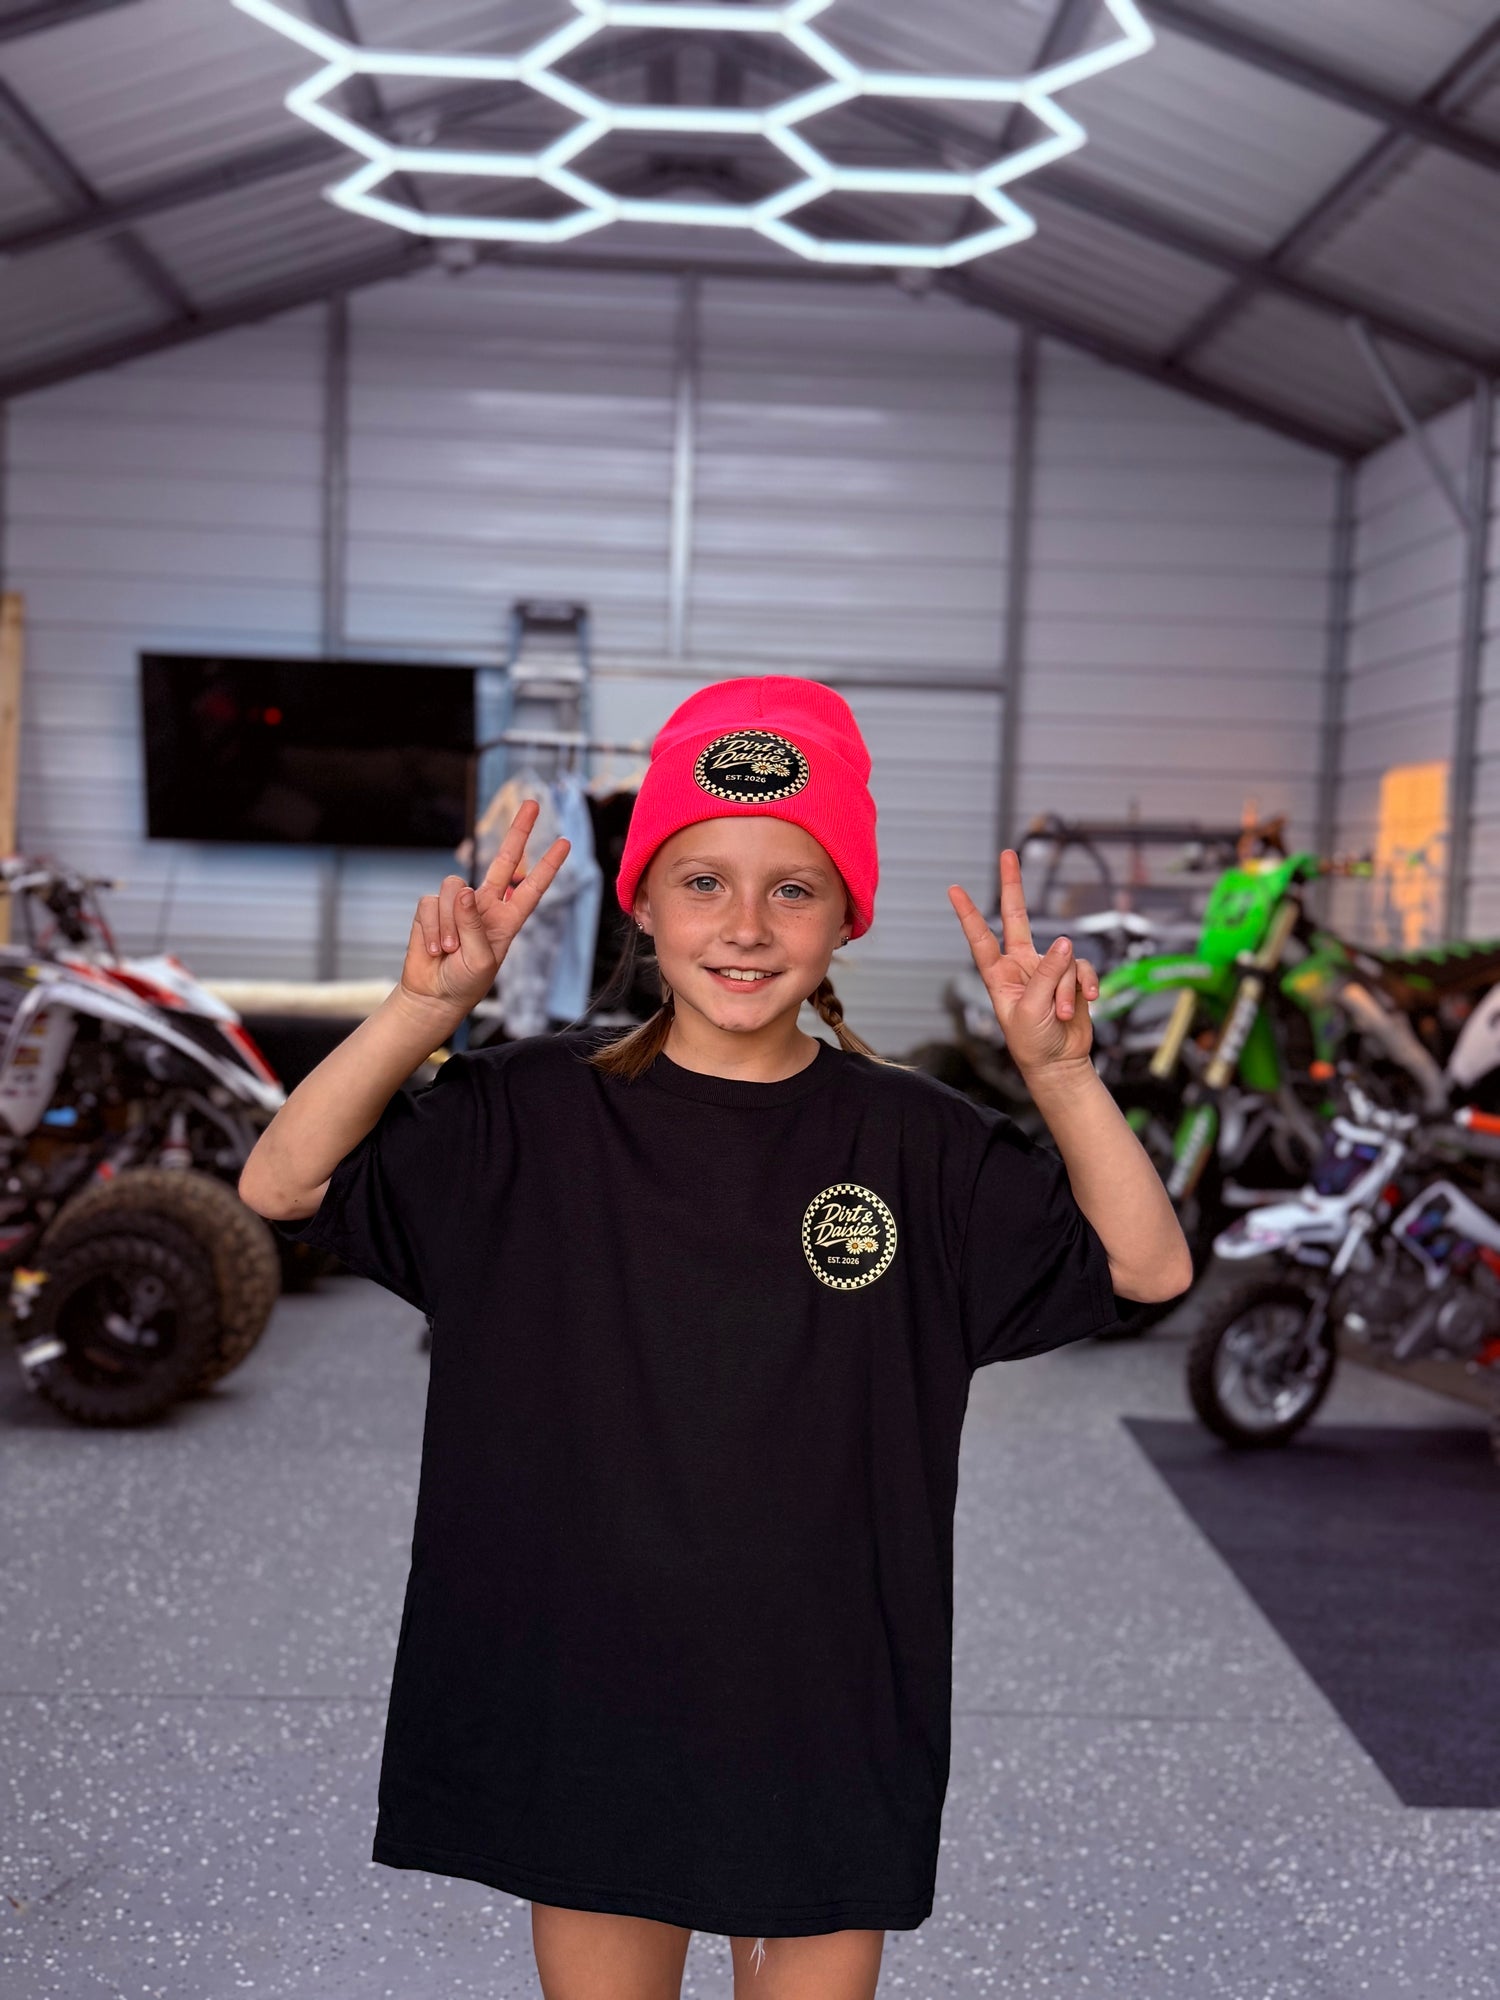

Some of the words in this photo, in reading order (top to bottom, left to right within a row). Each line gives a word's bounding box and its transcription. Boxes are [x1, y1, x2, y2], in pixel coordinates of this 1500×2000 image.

[720, 740, 780, 753] Dirt
[773, 747, 786, 756] &
[710, 751, 794, 769] Daisies
[744, 775, 767, 783] 2026
[818, 1203, 869, 1224] Dirt
[861, 1211, 874, 1223] &
[813, 1222, 881, 1246] Daisies
[827, 1256, 841, 1264] EST.
[842, 1257, 860, 1265] 2026
